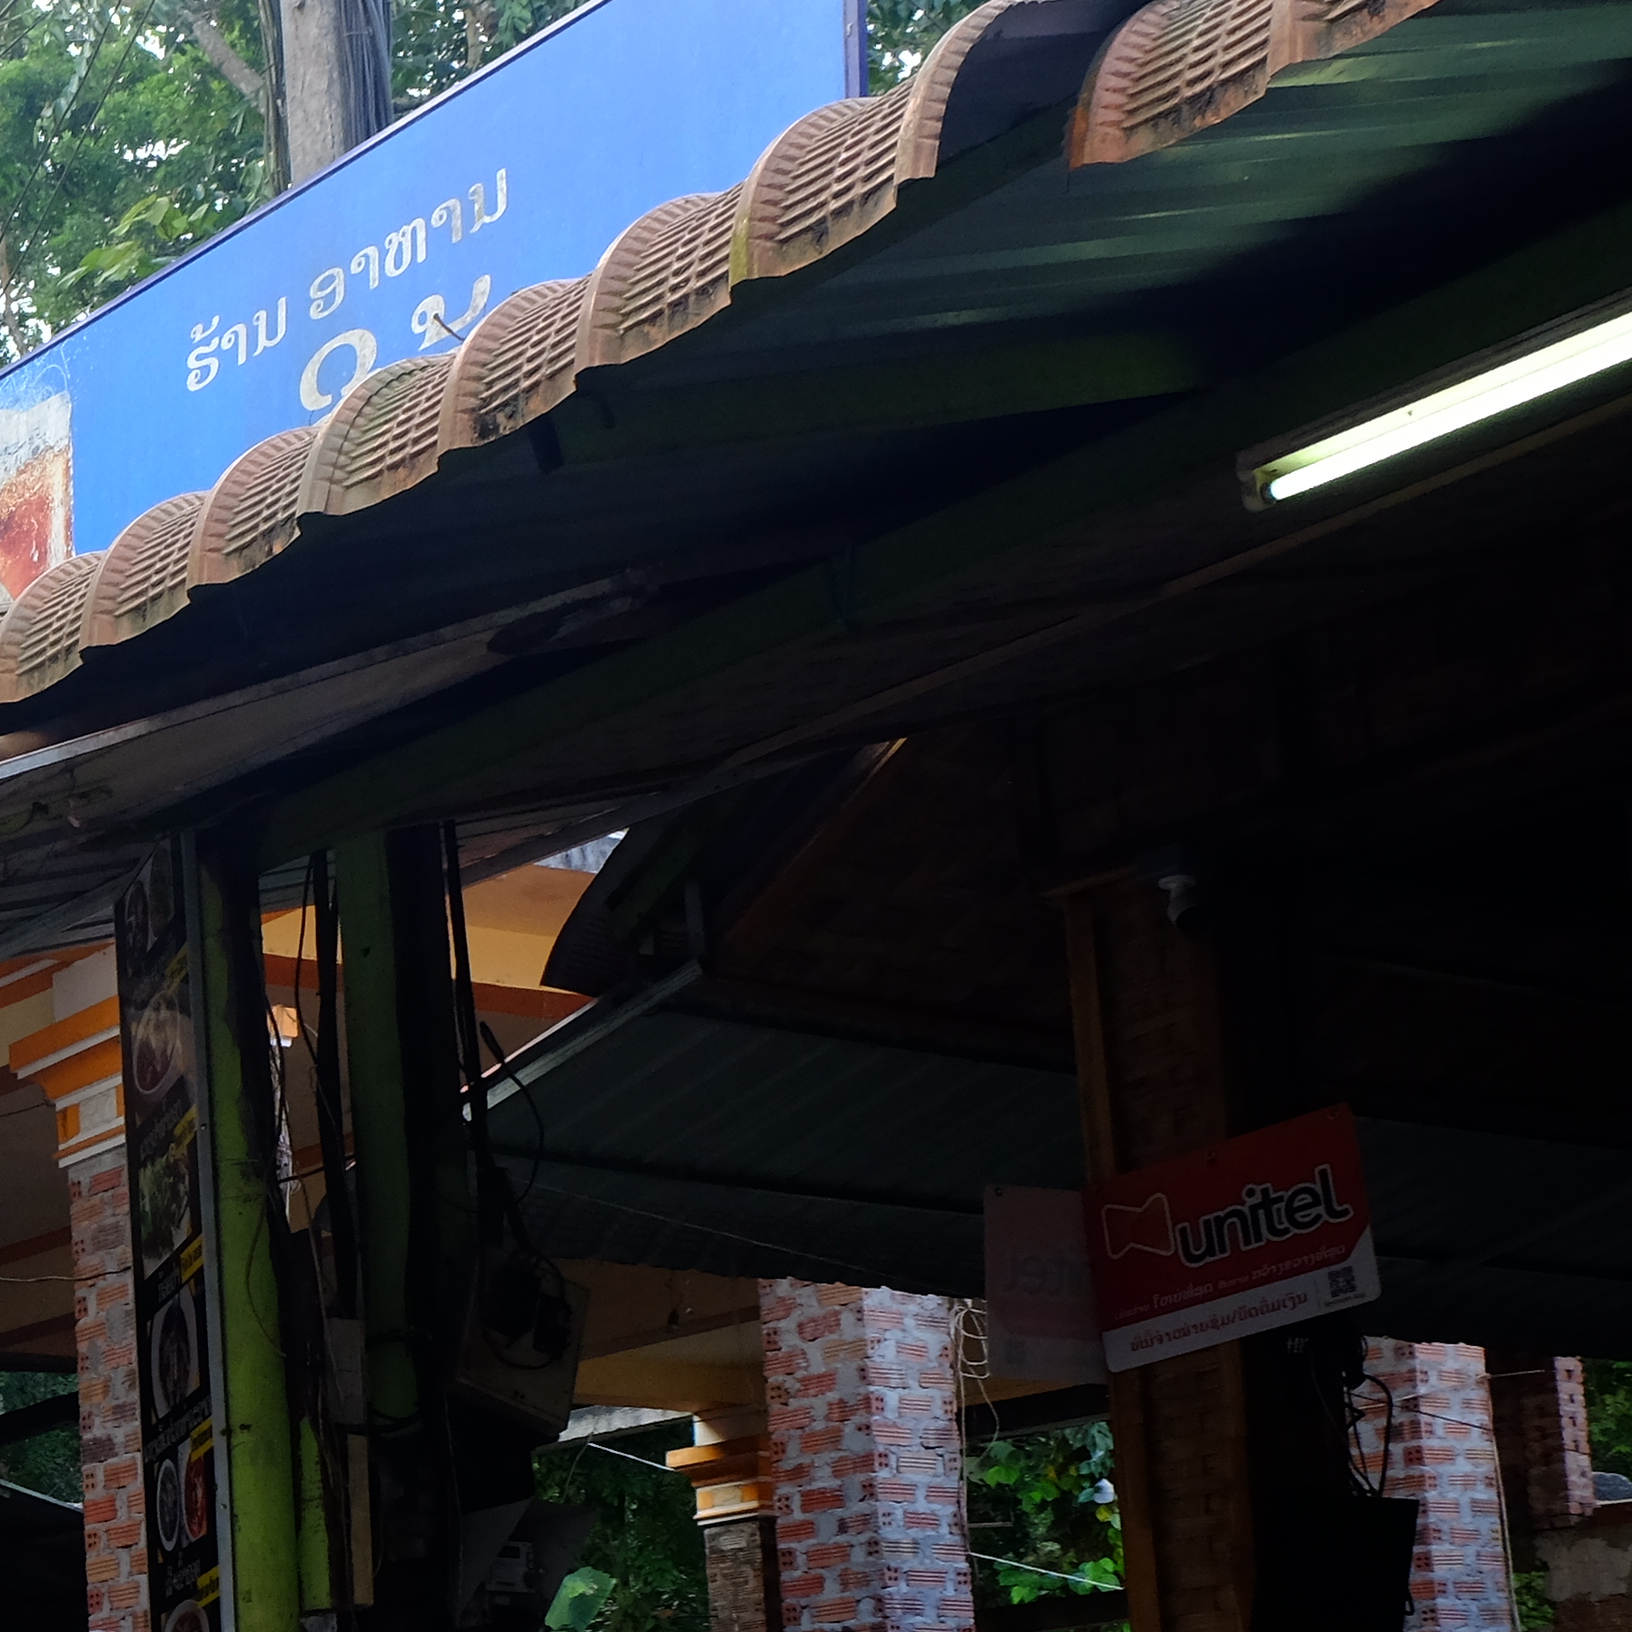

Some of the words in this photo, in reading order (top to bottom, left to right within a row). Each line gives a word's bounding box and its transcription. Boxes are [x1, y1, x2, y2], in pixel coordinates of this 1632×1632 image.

[186, 296, 287, 392] ຮ້ານ
[309, 167, 508, 321] ອາຫານ
[1174, 1164, 1353, 1267] unitel
